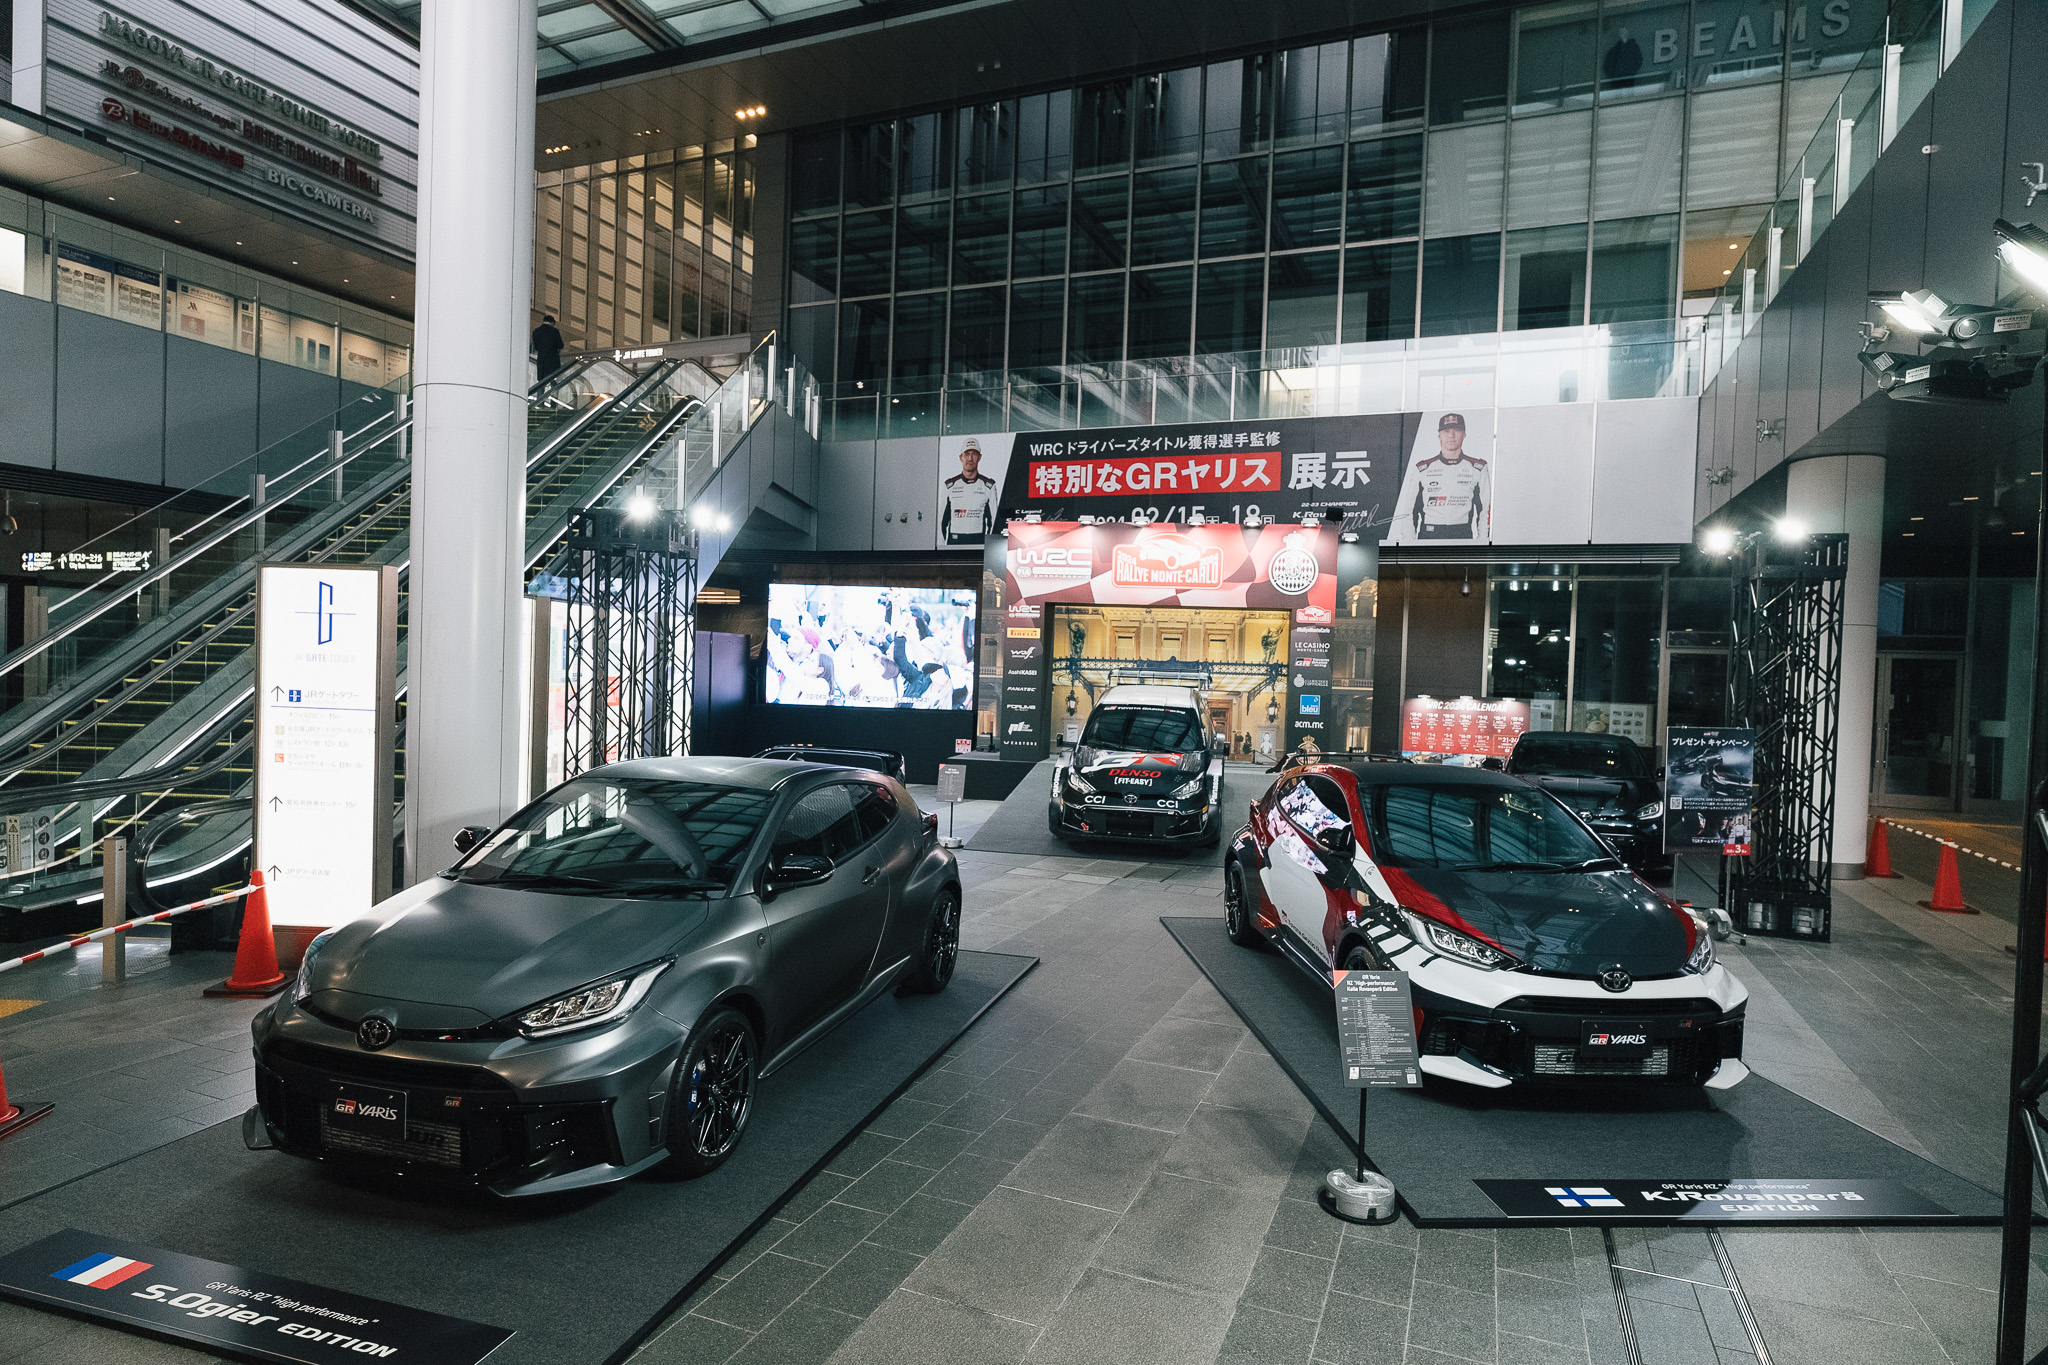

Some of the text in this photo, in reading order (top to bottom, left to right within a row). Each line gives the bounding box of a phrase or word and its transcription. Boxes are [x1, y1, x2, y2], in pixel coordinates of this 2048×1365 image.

[1652, 1, 1851, 64] BEAMS
[101, 11, 187, 68] NAGOYA
[132, 109, 245, 170] ビックカメラ
[267, 167, 375, 224] BIC CAMERA
[1030, 431, 1281, 456] WRC ドライバーズタイトル獲得選手監修
[1034, 450, 1371, 495] 特別なGRヤリス 展示
[1016, 547, 1093, 566] WRC
[1116, 560, 1220, 584] RALLYE MONTE-CARLO
[1008, 604, 1041, 613] WRC
[305, 652, 328, 663] GATE
[304, 689, 360, 700] JRゲートタワー
[1302, 705, 1319, 713] bleu
[1465, 702, 1508, 712] CALENDAR
[1294, 721, 1324, 729] acm.mc
[1672, 738, 1750, 747] プレゼント キャンペーン
[1108, 768, 1162, 778] DENSO
[1084, 795, 1107, 804] CCI
[1156, 799, 1179, 809] CCI
[1589, 1033, 1648, 1045] GR YARIS
[335, 1098, 398, 1121] GR YARIS
[1641, 1191, 1865, 1203] K.Rovanperä
[1719, 1204, 1820, 1212] EDITION
[205, 1281, 227, 1291] GR
[223, 1284, 253, 1298] Yaris
[249, 1291, 273, 1302] RZ
[130, 1284, 398, 1358] S.Ogier EDITION
